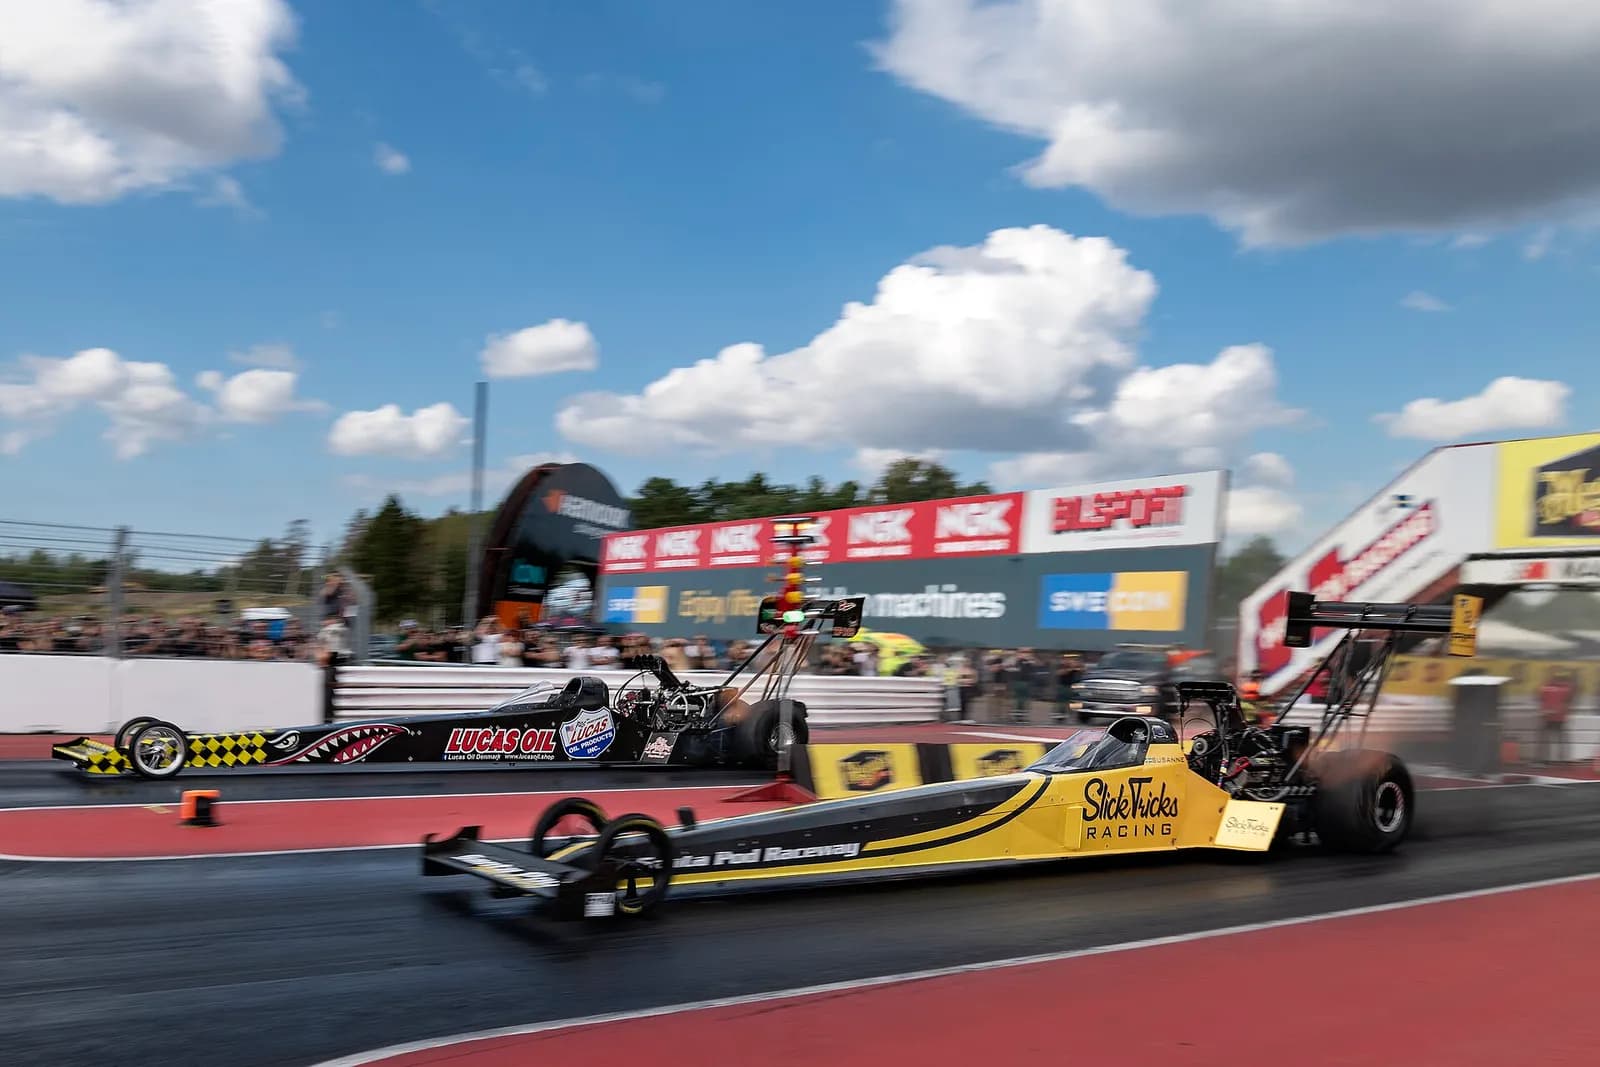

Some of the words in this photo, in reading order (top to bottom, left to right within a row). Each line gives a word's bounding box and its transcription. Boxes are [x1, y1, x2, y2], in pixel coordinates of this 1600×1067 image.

[847, 509, 914, 544] NGK
[935, 500, 1013, 538] NGK
[445, 728, 520, 753] LUCAS
[520, 728, 556, 753] OIL
[570, 718, 608, 744] LUCAS
[581, 731, 613, 748] PRODUCTS
[1087, 823, 1171, 839] RACING
[763, 842, 860, 862] Raceway
